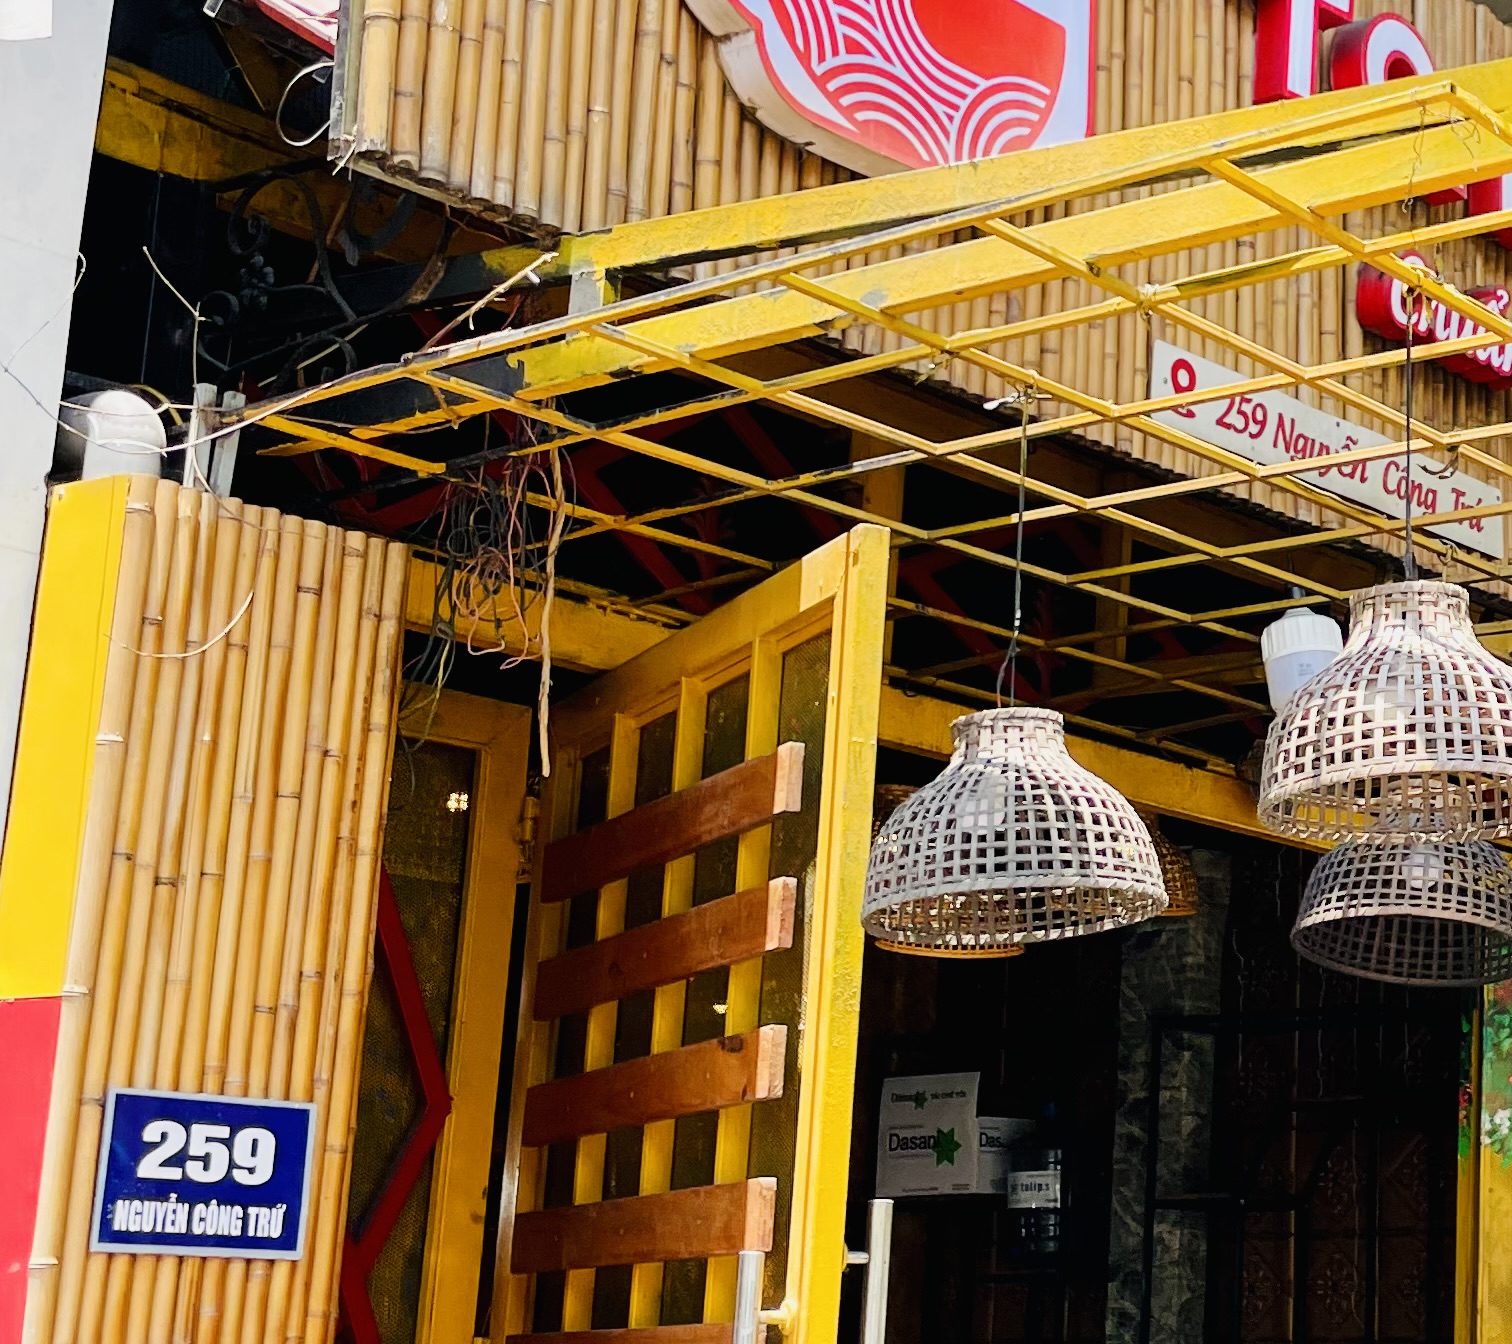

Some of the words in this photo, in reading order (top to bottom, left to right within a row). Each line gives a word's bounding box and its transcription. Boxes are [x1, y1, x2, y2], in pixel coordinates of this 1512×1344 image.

[1215, 394, 1269, 439] 259
[1273, 412, 1369, 484] Nguyễn
[1383, 460, 1438, 516] Công
[135, 1118, 277, 1187] 259
[888, 1132, 939, 1152] Dasan
[112, 1192, 189, 1235] NGUYỄN
[192, 1198, 243, 1238] CÔNG
[247, 1202, 287, 1239] TRỨ
